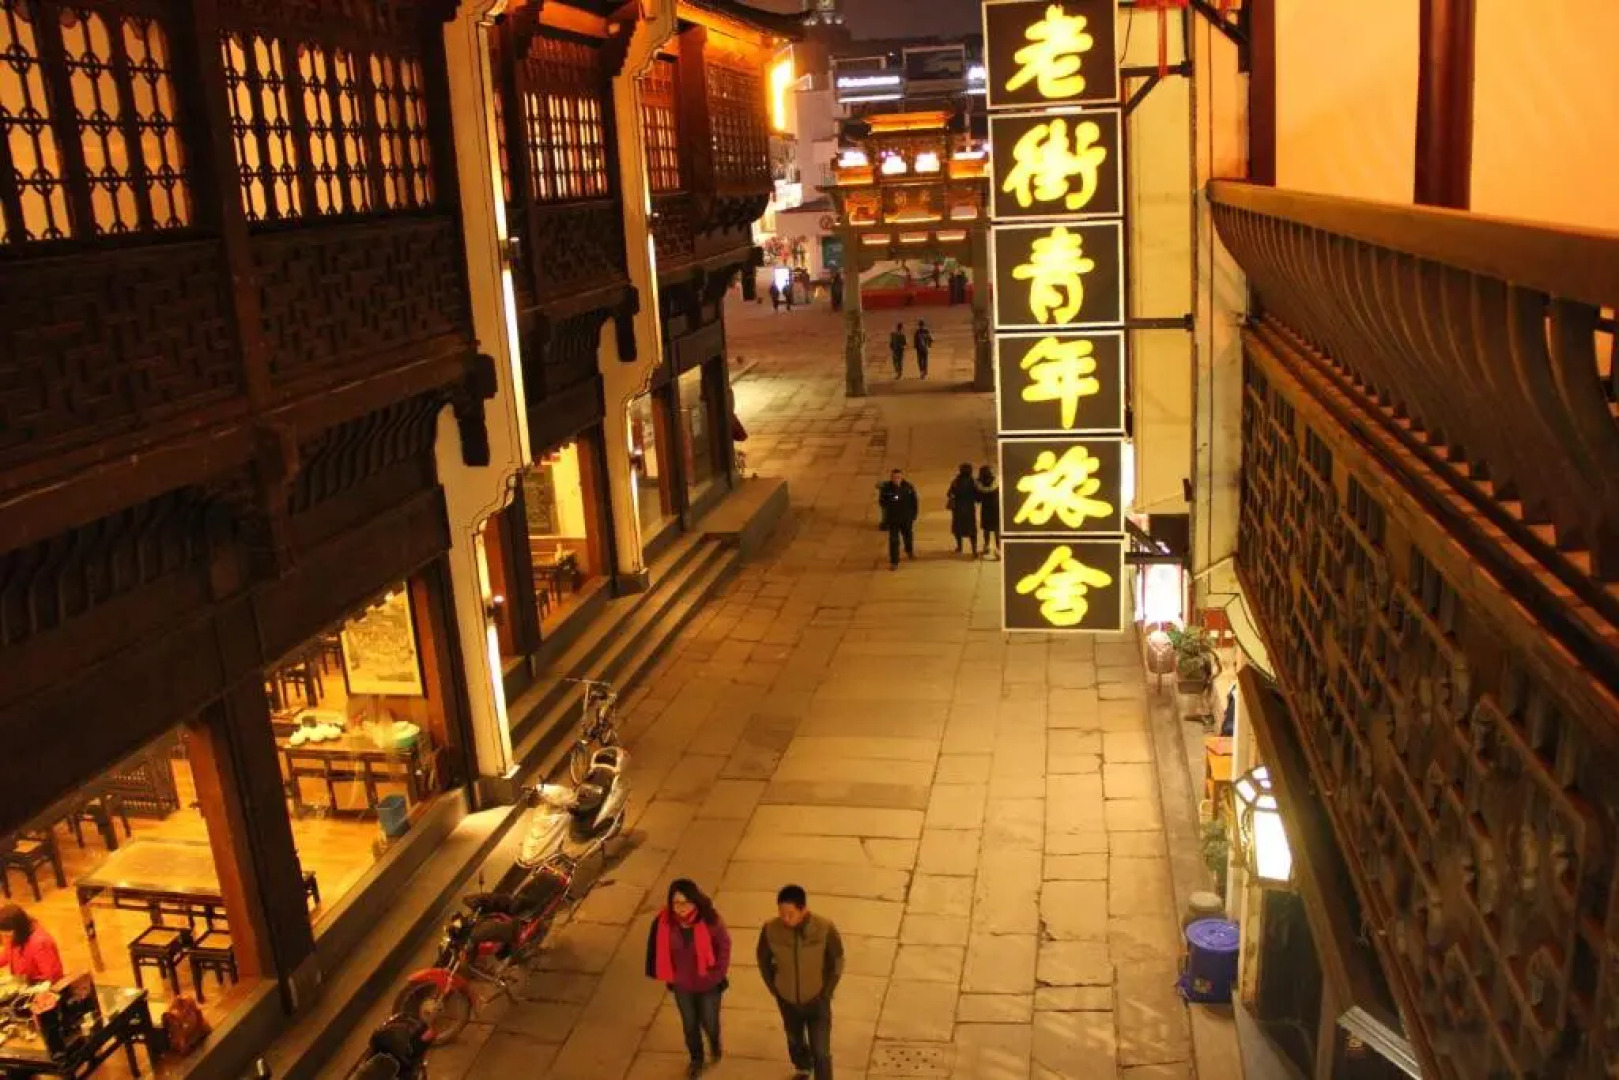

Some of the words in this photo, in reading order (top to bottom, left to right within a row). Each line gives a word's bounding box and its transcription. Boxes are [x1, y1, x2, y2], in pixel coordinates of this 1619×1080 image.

[1003, 4, 1113, 626] 老街青年旅舍
